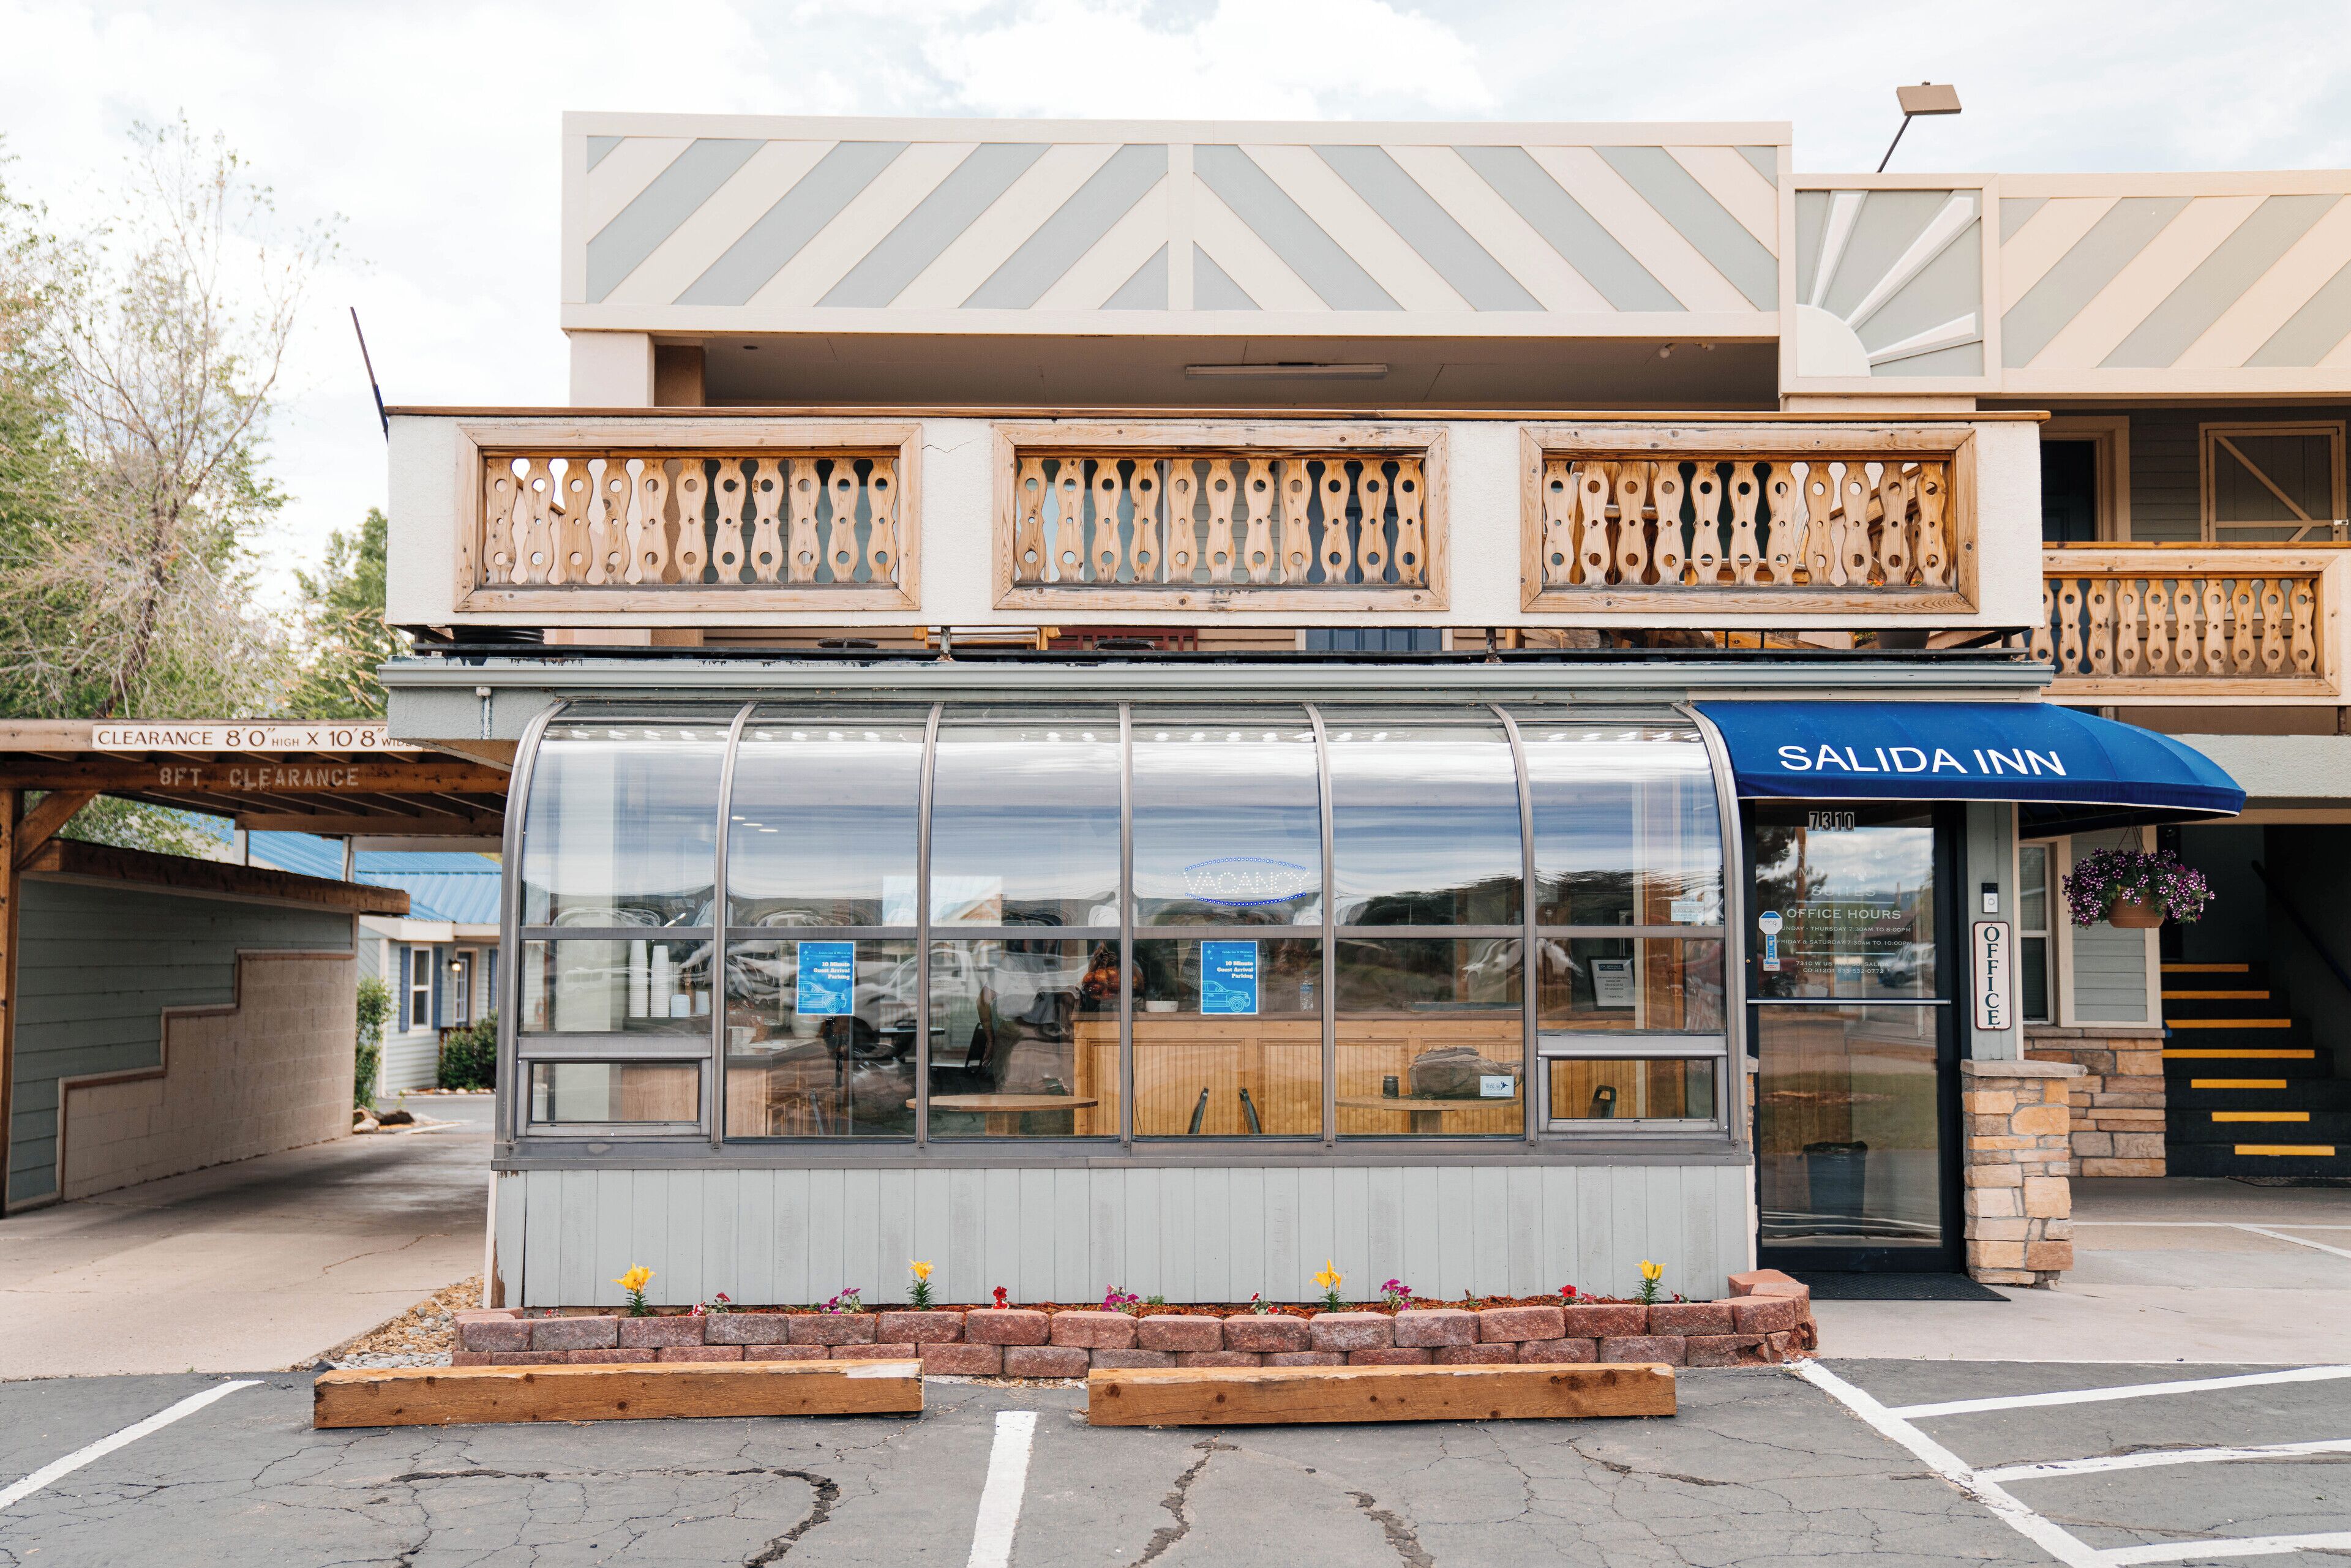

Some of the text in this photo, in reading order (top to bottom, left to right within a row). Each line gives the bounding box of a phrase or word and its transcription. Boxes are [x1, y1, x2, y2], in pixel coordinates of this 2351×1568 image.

[97, 730, 213, 745] CLEARANCE
[271, 738, 299, 746] HIGH
[306, 731, 320, 745] X
[1777, 744, 2067, 776] SALIDA INN
[159, 767, 359, 791] 8FT CLEARANCE
[1810, 811, 1854, 831] 7310
[1182, 871, 1310, 894] VACANCY
[1811, 885, 1876, 897] SUITES
[1787, 909, 1901, 920] OFFICE HOURS
[1984, 926, 2001, 1026] OFFICE
